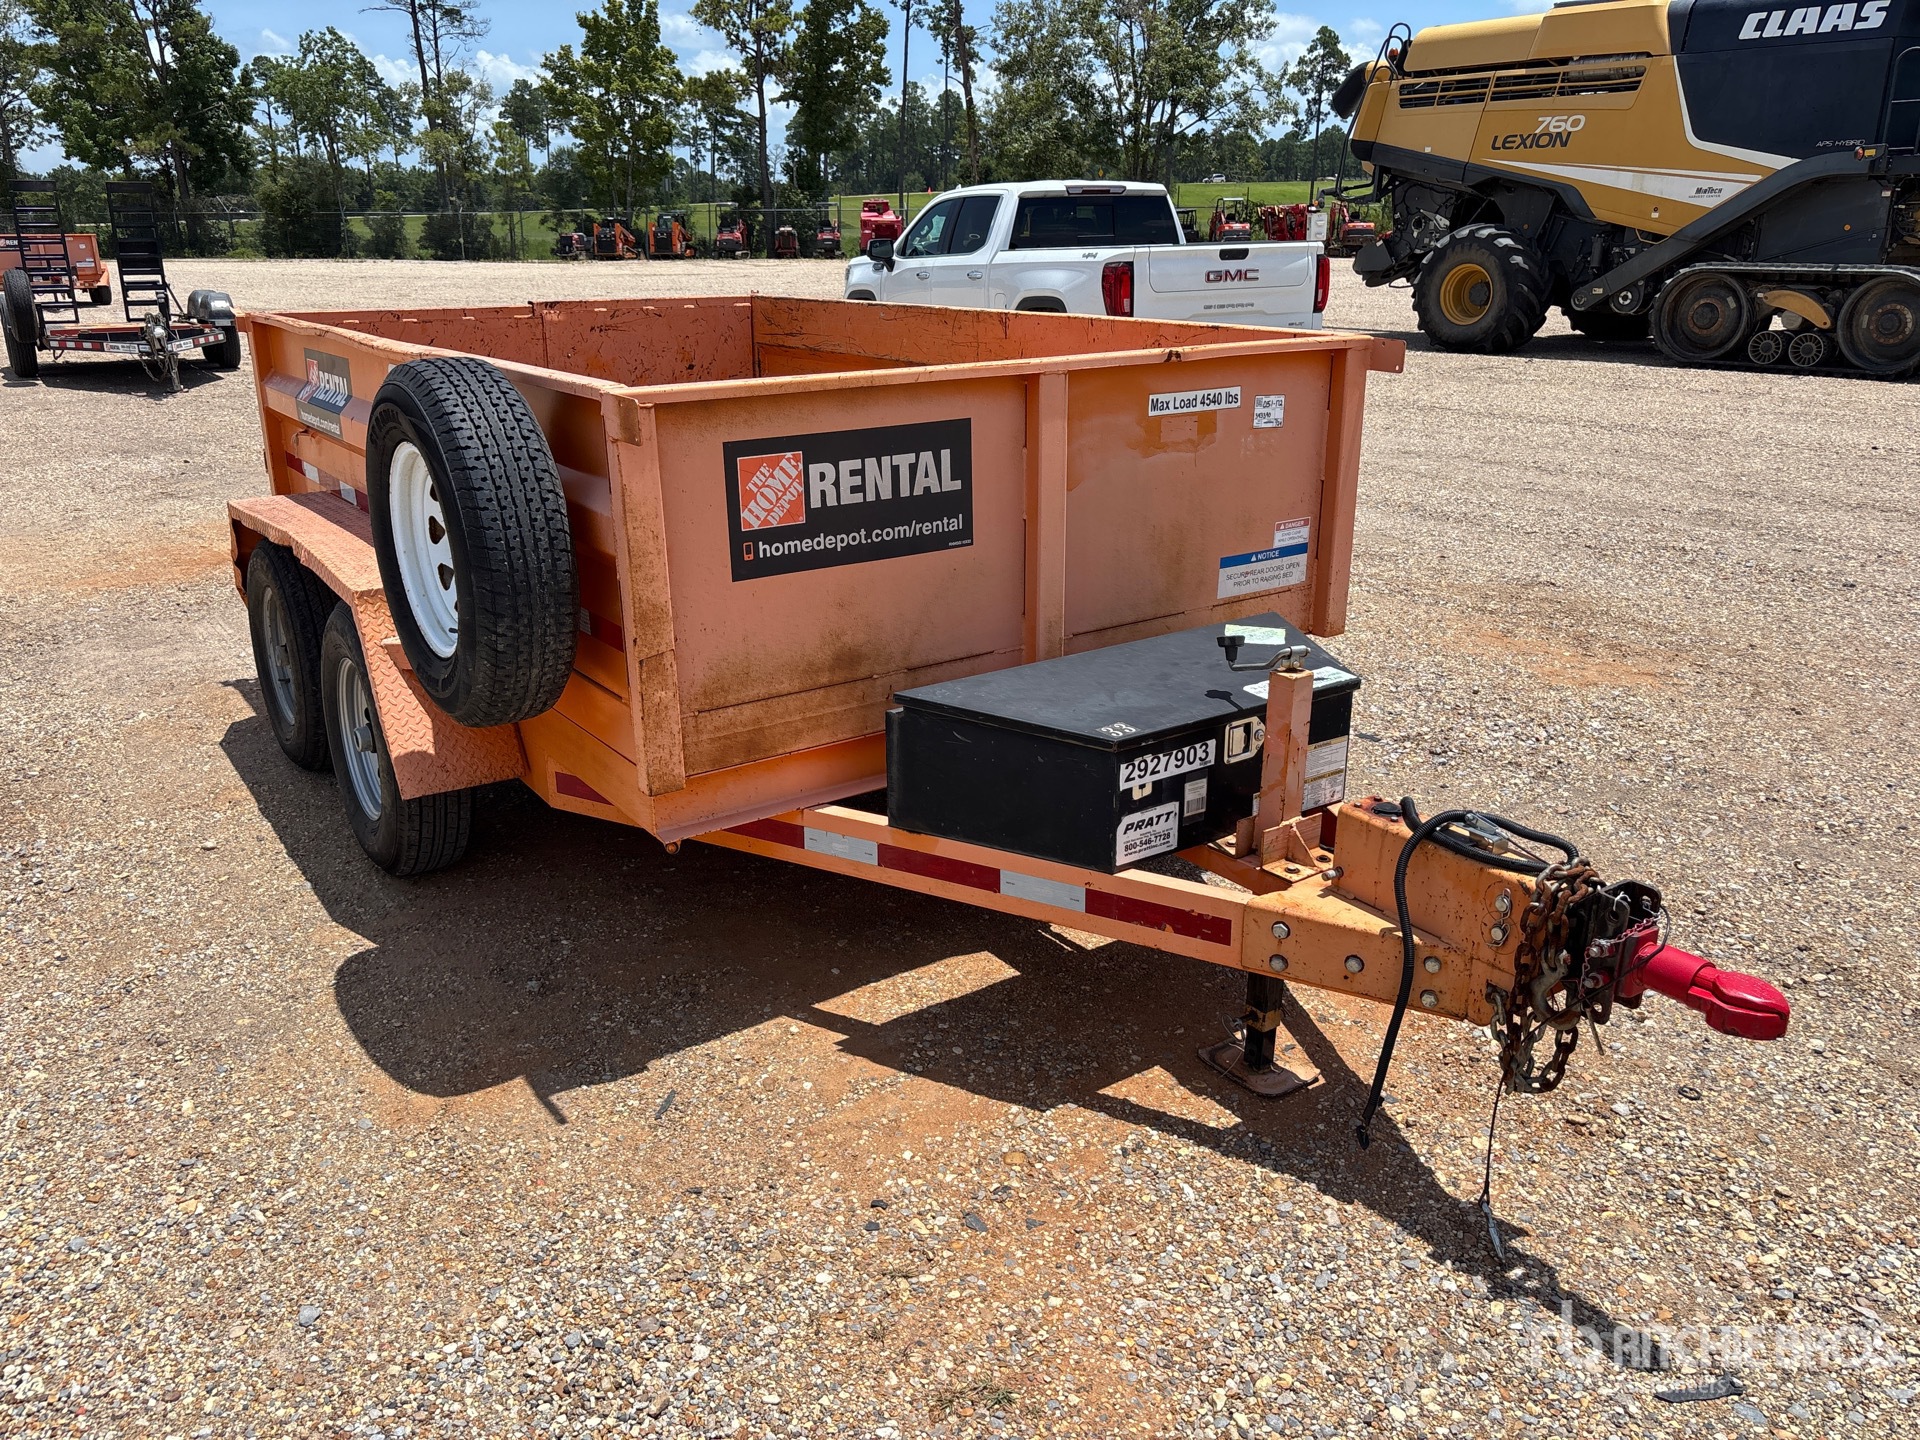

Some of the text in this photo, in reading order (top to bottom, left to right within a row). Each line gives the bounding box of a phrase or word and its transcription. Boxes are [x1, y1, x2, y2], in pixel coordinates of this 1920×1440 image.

[1738, 1, 1890, 40] CLAAS
[1534, 115, 1586, 133] 760
[1491, 131, 1572, 151] LEXION
[1205, 268, 1260, 283] GMC
[1203, 302, 1255, 310] SIERRA
[312, 371, 349, 407] RENTAL
[1150, 391, 1239, 412] Max Load 4540 lbs
[746, 463, 773, 493] THE
[808, 449, 962, 509] RENTAL
[741, 452, 803, 529] HOME
[766, 479, 804, 526] DEPOT
[1285, 520, 1304, 529] DANGER
[758, 514, 963, 559] homedepot.com/rental
[1257, 550, 1280, 560] NOTICE
[1226, 562, 1300, 581] SECURE REAR DOORS OPEN
[1233, 571, 1293, 587] PRIOR TO RAISING BED
[1101, 723, 1136, 737] 33
[1123, 742, 1209, 784] 2927903
[1123, 810, 1174, 835] PRATT
[1124, 832, 1171, 852] 800-546-7728
[1124, 840, 1171, 857] www.prattinc.com
